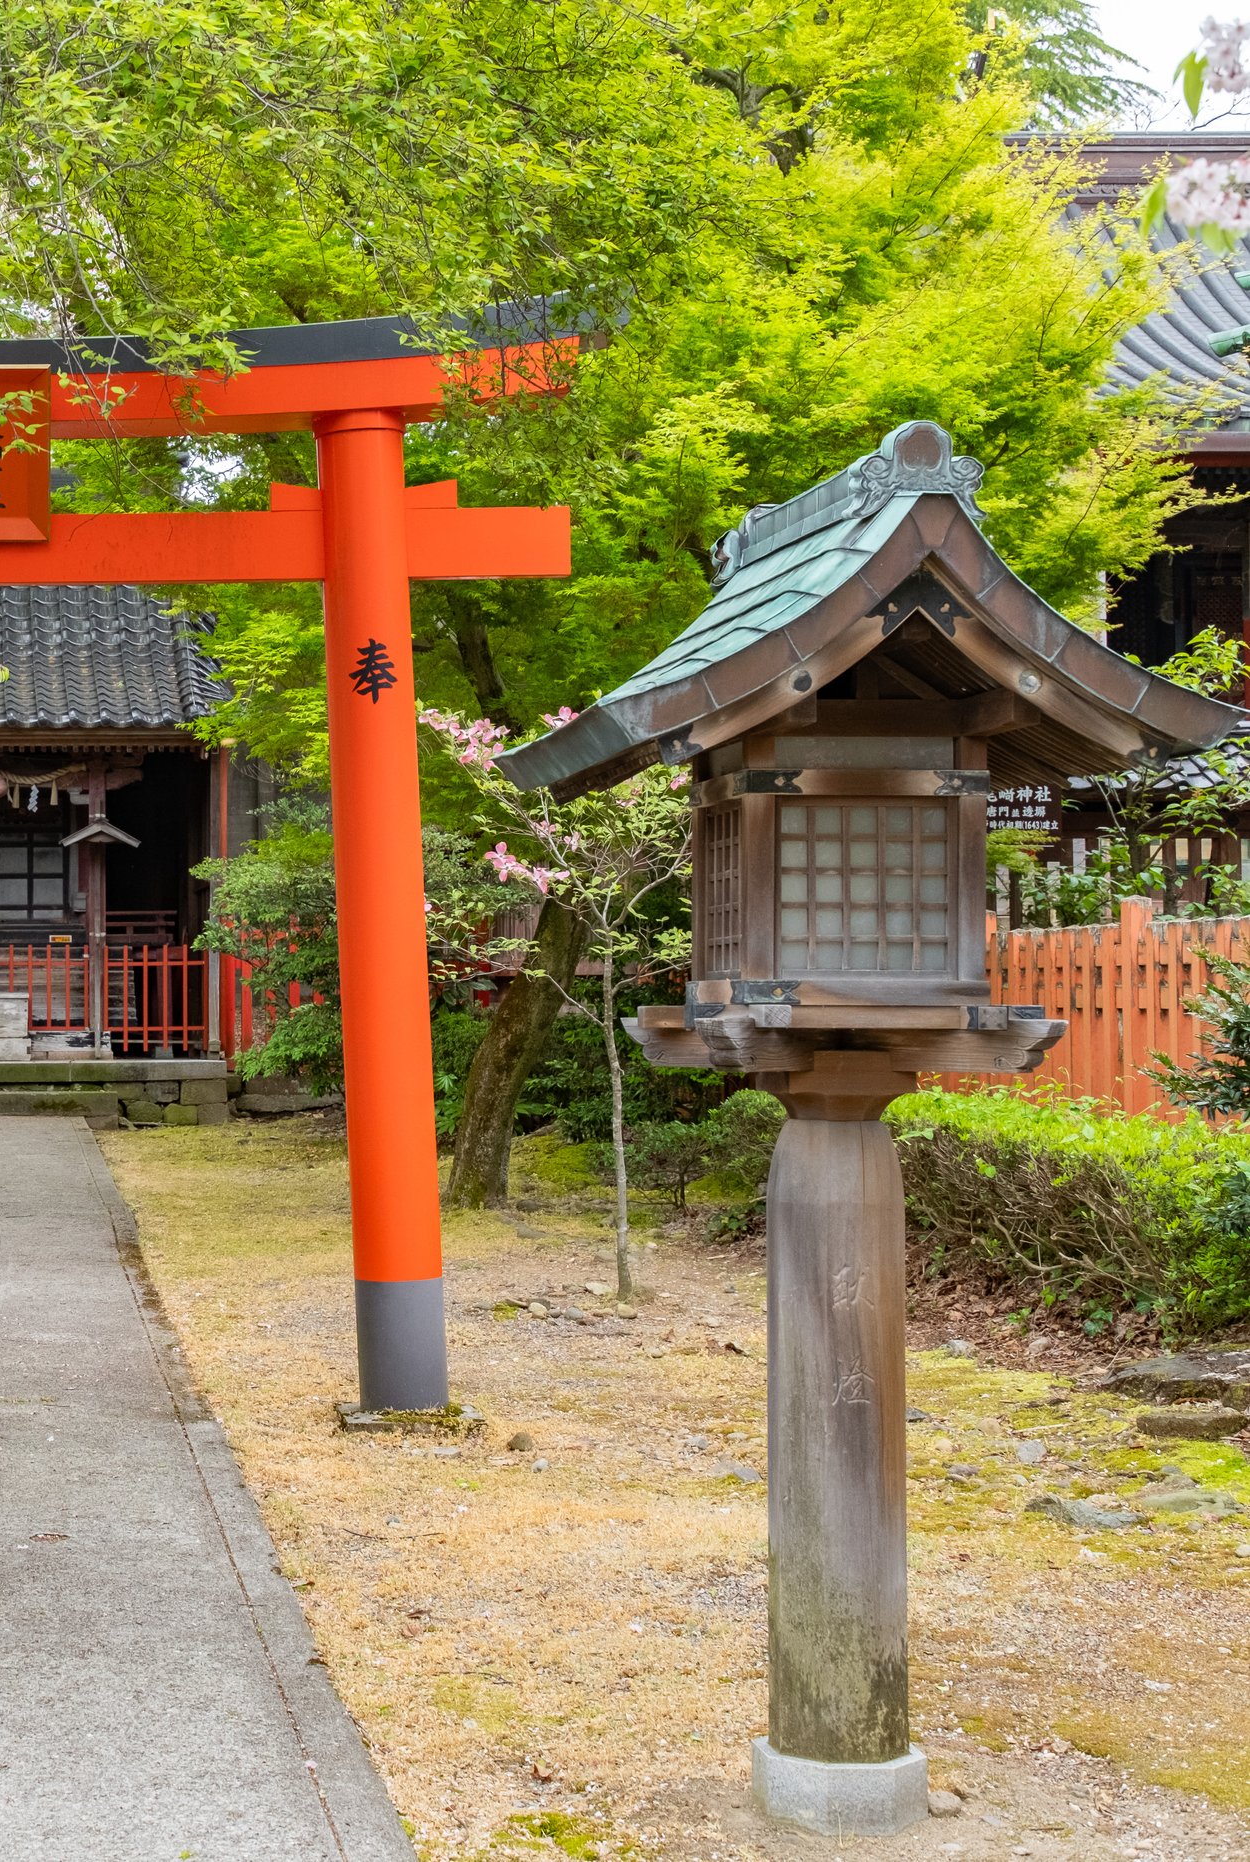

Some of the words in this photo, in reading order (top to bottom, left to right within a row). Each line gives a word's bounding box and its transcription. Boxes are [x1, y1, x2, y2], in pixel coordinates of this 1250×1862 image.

[349, 638, 398, 705] 奉
[986, 819, 1059, 831] 時代初期(1643)建立
